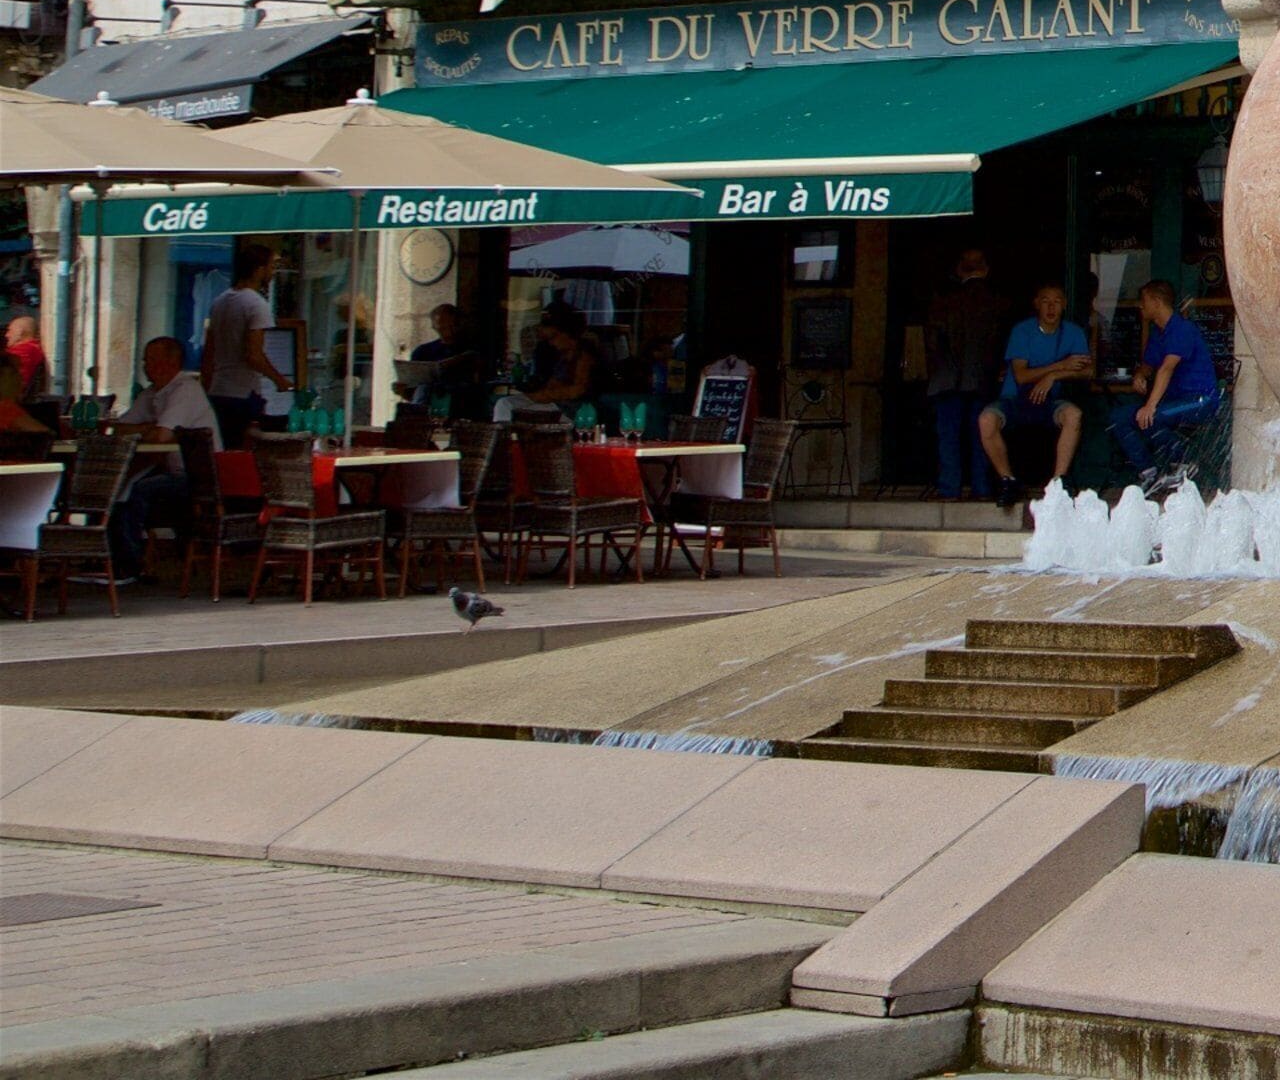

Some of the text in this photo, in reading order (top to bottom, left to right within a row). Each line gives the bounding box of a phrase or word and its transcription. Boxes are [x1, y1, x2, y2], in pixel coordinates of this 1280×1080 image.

[506, 18, 624, 71] CAFE
[647, 14, 715, 63] DU
[377, 192, 539, 224] Restaurant
[718, 180, 891, 215] Bar à Vins
[143, 201, 210, 232] Café
